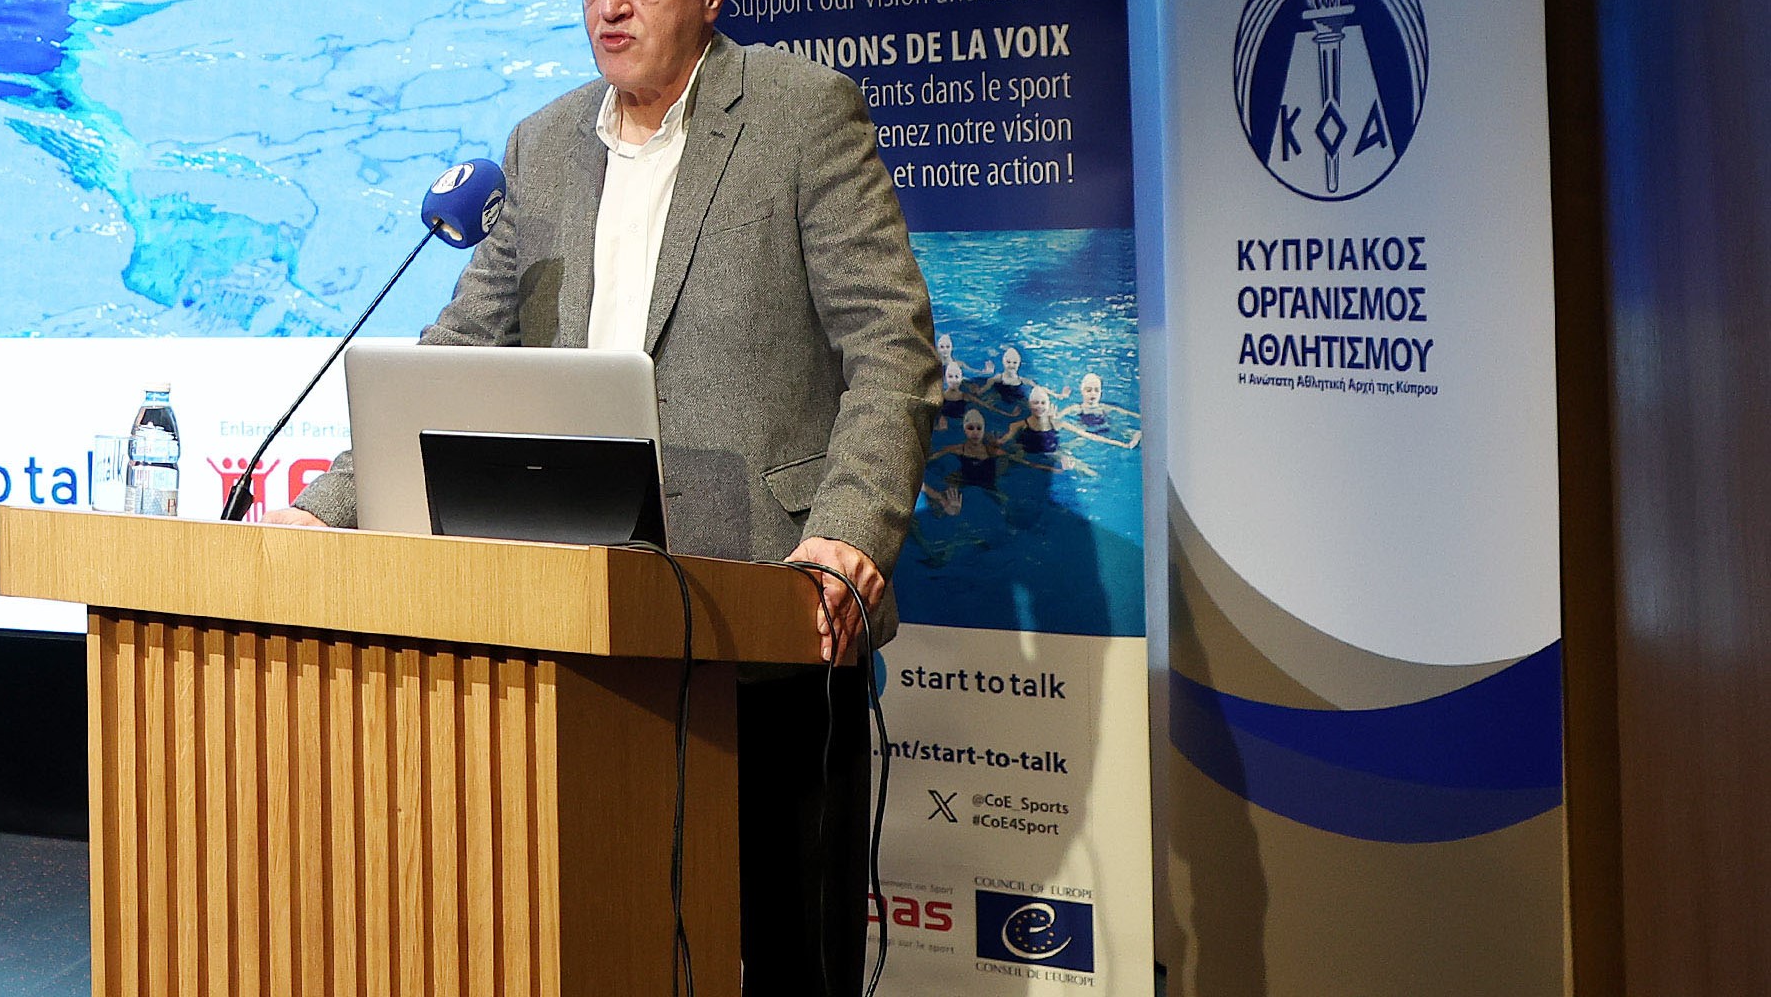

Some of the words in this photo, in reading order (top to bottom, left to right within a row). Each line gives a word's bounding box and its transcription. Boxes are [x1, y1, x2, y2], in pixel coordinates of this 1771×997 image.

[905, 31, 943, 65] DE
[951, 28, 989, 63] LA
[989, 23, 1071, 59] VOIX
[859, 76, 915, 108] fants
[921, 73, 975, 105] dans
[981, 71, 1003, 102] le
[1008, 71, 1072, 107] sport
[936, 116, 996, 145] notre
[1002, 113, 1073, 142] vision
[893, 161, 916, 189] et
[921, 158, 980, 187] notre
[986, 154, 1061, 187] action
[1237, 236, 1428, 272] ΚΥΠΡΙΑΚΟΣ
[1237, 285, 1428, 322] ΟΡΓΑΝΙΣΜΟΣ
[1238, 332, 1434, 373] ΑΘΛΗΤΙΣΜΟΥ
[1348, 377, 1375, 394] Αρχή
[1396, 381, 1439, 397] Κύπρου
[219, 420, 294, 441] Enlard
[302, 420, 350, 437] Partia
[24, 451, 94, 505] tal
[900, 665, 969, 691] start
[974, 670, 1005, 695] to
[1008, 672, 1066, 699] talk
[873, 740, 1069, 774] .nt/start-to-talk
[972, 793, 1070, 815] @CoE_Sports
[972, 815, 1060, 835] #CoE4Sport
[974, 876, 1026, 892] COUNCIL
[1051, 885, 1093, 900] EUROPE
[975, 962, 1022, 977] CONSEIL
